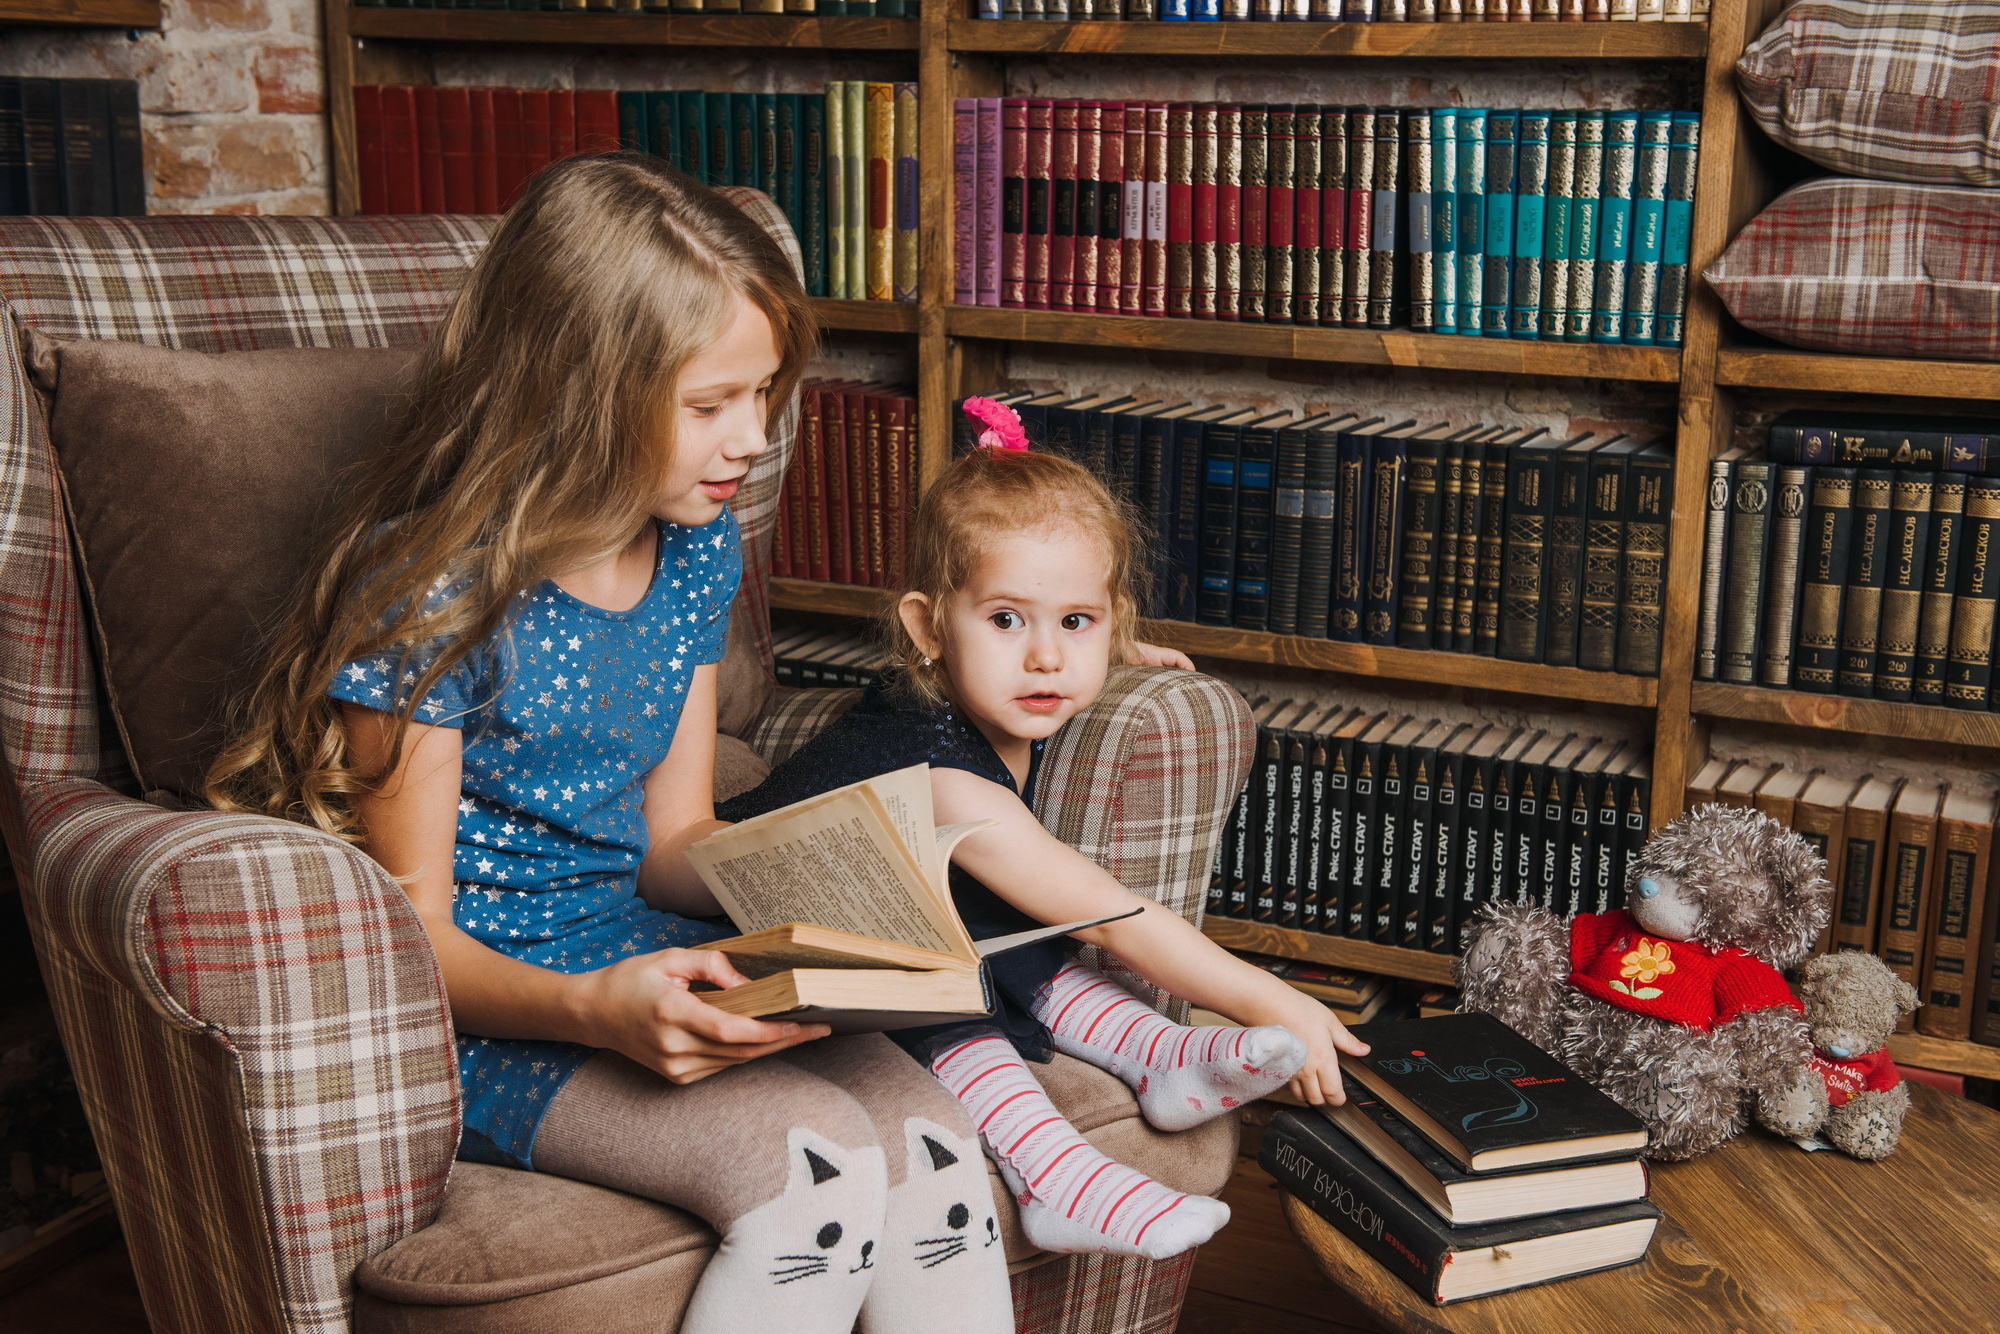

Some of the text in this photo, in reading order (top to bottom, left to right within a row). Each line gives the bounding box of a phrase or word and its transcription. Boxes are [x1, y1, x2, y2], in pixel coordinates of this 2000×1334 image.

[851, 428, 863, 503] ШОЛОХОВ
[868, 429, 882, 572] МИХАИЛ ШОЛОХОВ
[887, 432, 900, 506] ШОЛОХОВ
[1926, 663, 1935, 675] 3
[1962, 669, 1970, 681] 4
[1236, 794, 1248, 830] Хэдли
[1262, 764, 1278, 884] Джеймс Хэдли ЧЕЙЗ
[1287, 766, 1303, 886] Джеймс Хэдли ЧЕЙЗ
[1308, 770, 1324, 891] Джеймс Хэдли ЧЕЙЗ
[1328, 808, 1342, 882] Рекс СТАУТ
[1353, 812, 1367, 886] Рекс СТАУТ
[1234, 831, 1246, 880] Джеймс
[1380, 813, 1395, 888] Рекс СТАУТ
[1408, 819, 1424, 894] Рекс СТАУТ
[1434, 823, 1449, 898] Рекс СТАУТ
[1464, 827, 1478, 902] Рекс СТАУТ
[1490, 829, 1504, 904] Рекс СТАУТ
[1516, 834, 1530, 909] Рекс СТАУТ
[1546, 840, 1556, 882] СТАУТ
[1570, 842, 1582, 888] СТАУТ
[1598, 844, 1611, 888] СТАУТ
[1209, 888, 1223, 898] 20
[1231, 892, 1246, 902] 21
[1258, 898, 1274, 908] 28
[1282, 901, 1297, 912] 29
[1304, 904, 1318, 915] 31
[1510, 1076, 1537, 1084] КИМ
[1514, 1076, 1566, 1088] АНАТОЛИЙ
[1276, 1138, 1386, 1242] МОРСКАЯ ДУША
